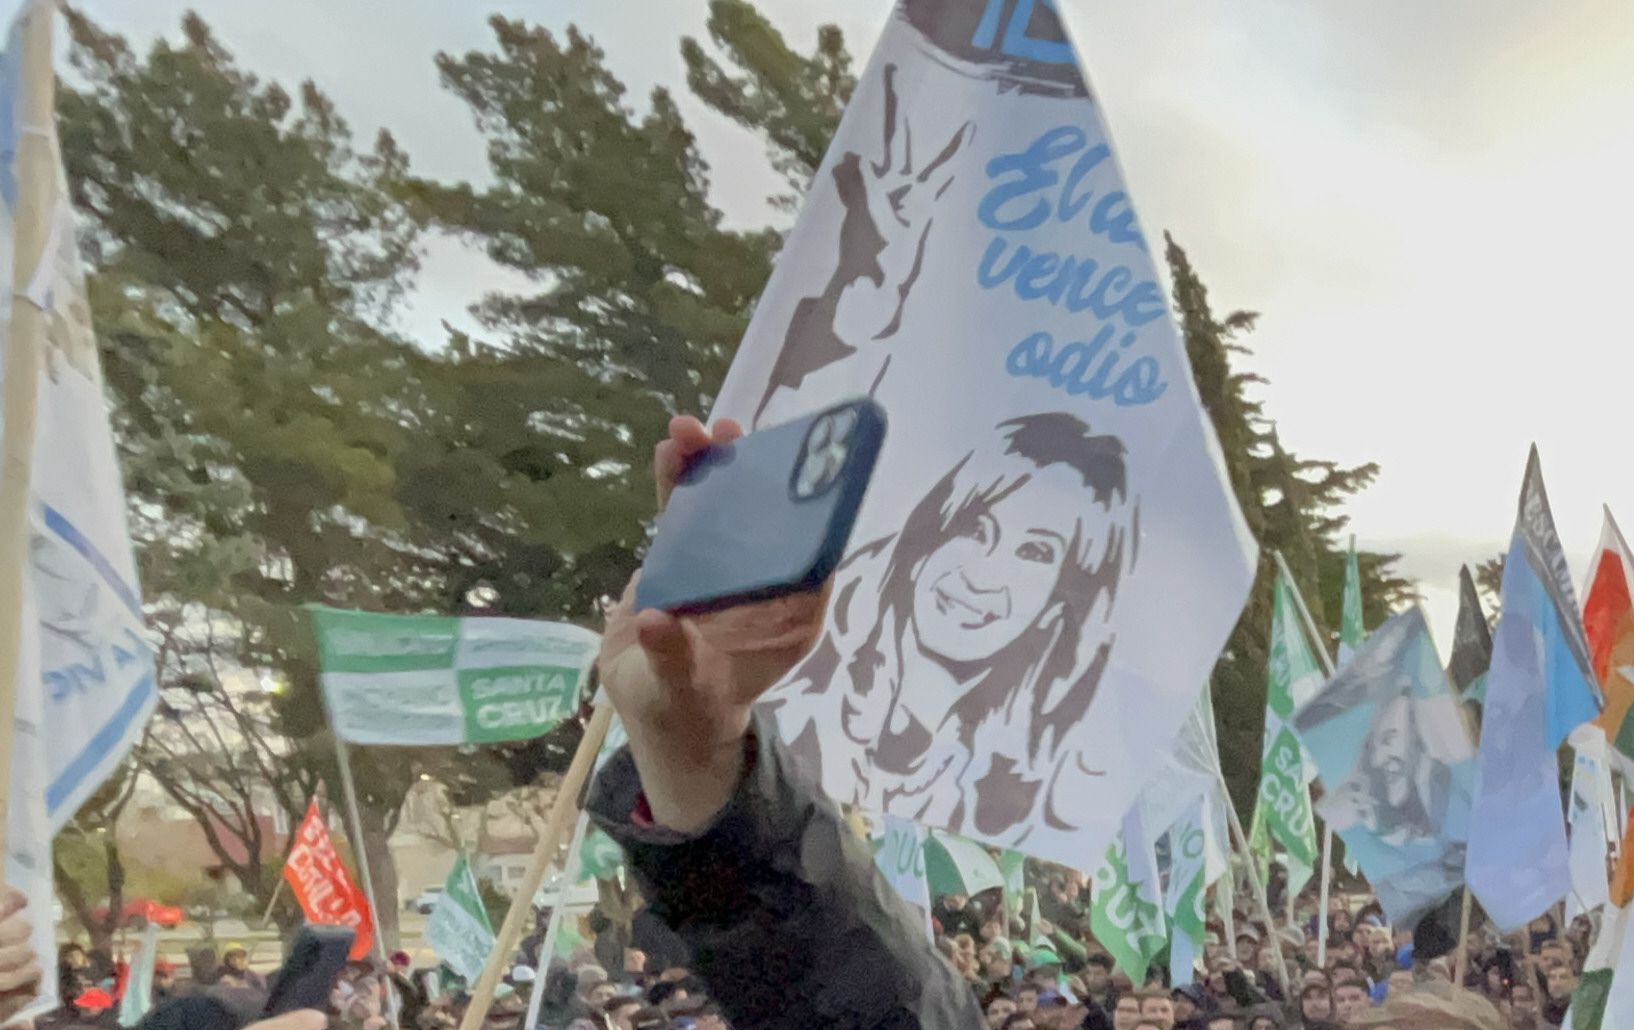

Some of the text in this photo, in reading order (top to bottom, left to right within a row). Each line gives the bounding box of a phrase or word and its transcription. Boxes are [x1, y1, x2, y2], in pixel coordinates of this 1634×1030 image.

[976, 125, 1111, 231] El
[977, 236, 1166, 327] vence
[1004, 324, 1169, 407] odio
[475, 695, 567, 730] CRUZ
